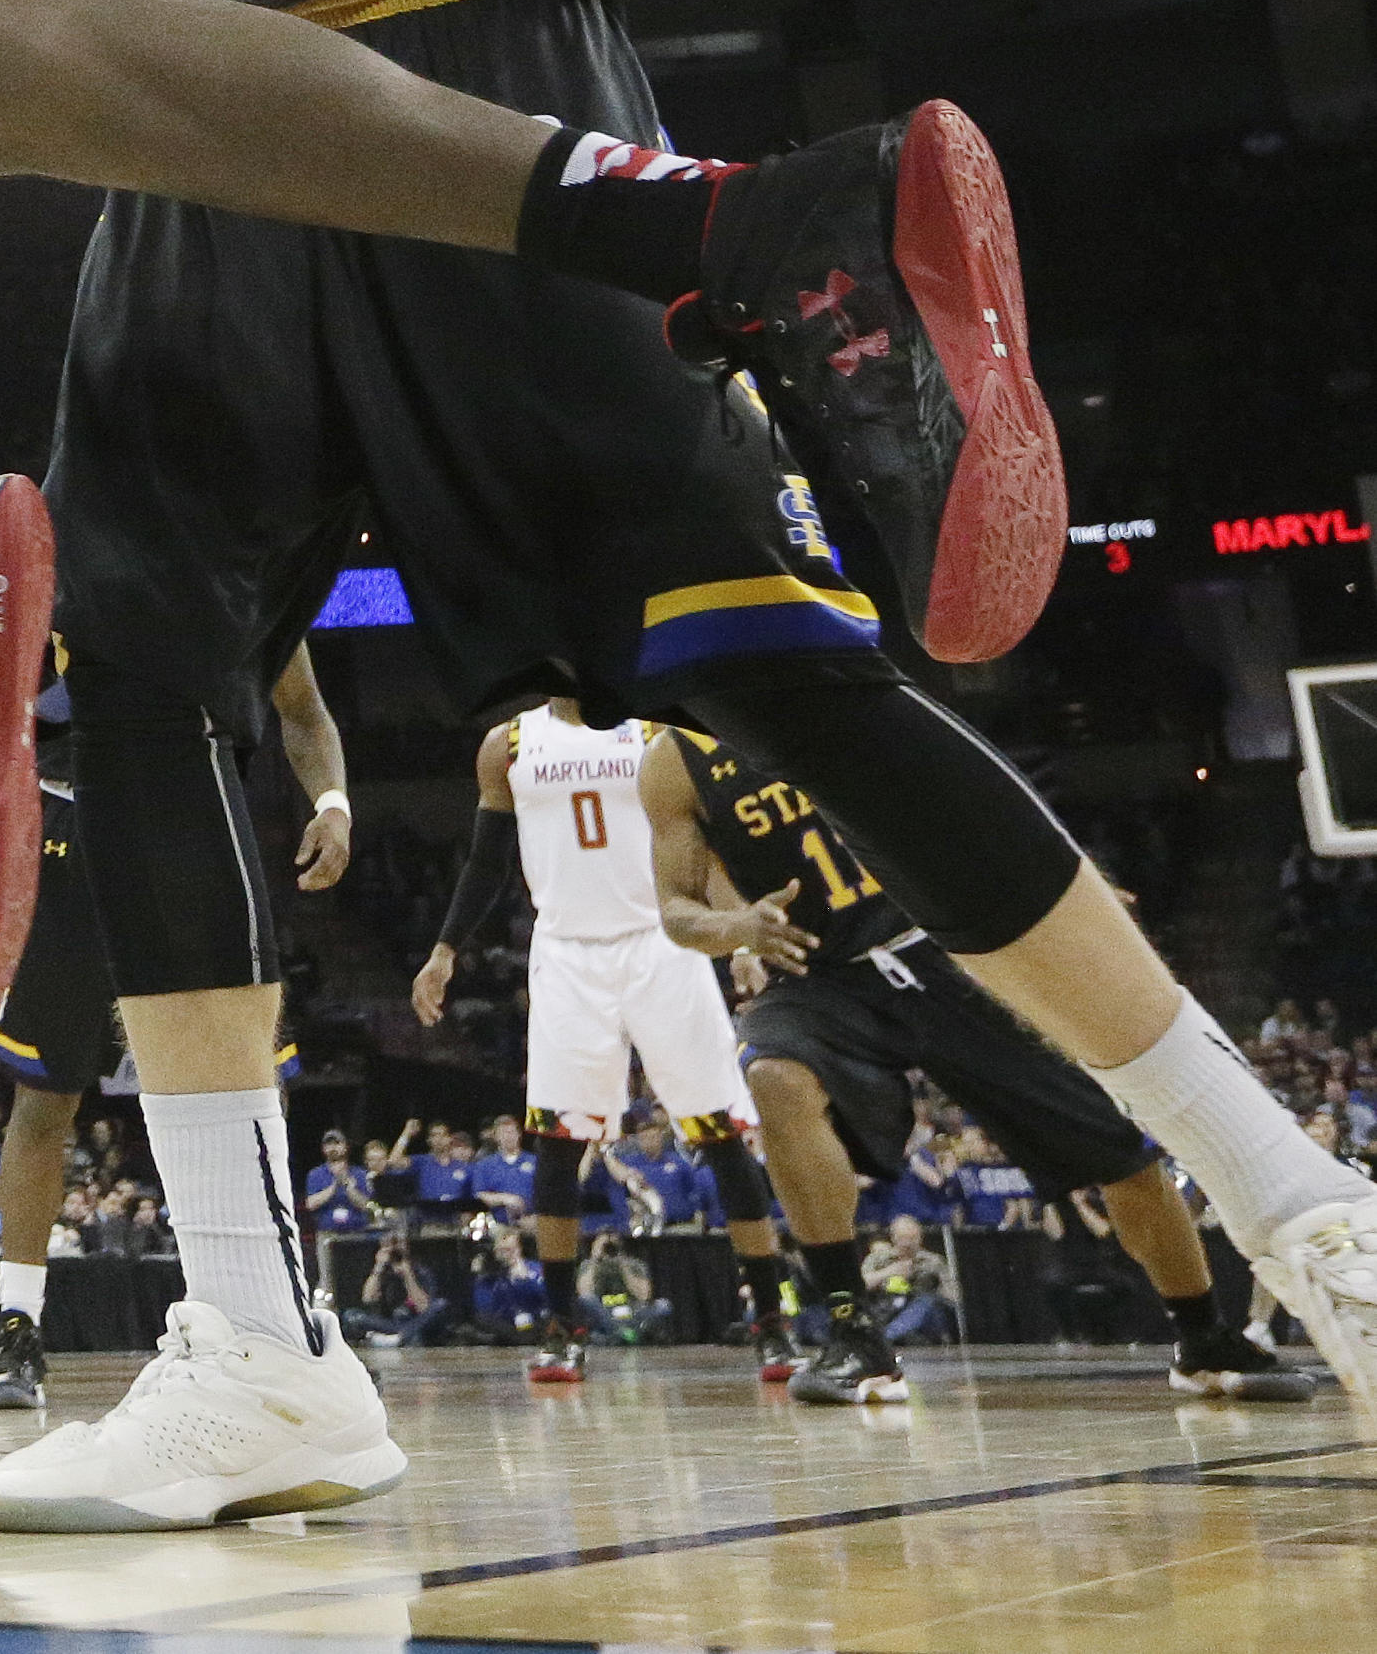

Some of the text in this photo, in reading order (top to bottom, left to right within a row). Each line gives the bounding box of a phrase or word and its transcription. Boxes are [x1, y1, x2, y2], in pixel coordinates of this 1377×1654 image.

[1105, 541, 1131, 574] 3
[534, 759, 635, 784] MARYLAND
[571, 791, 607, 850] 0
